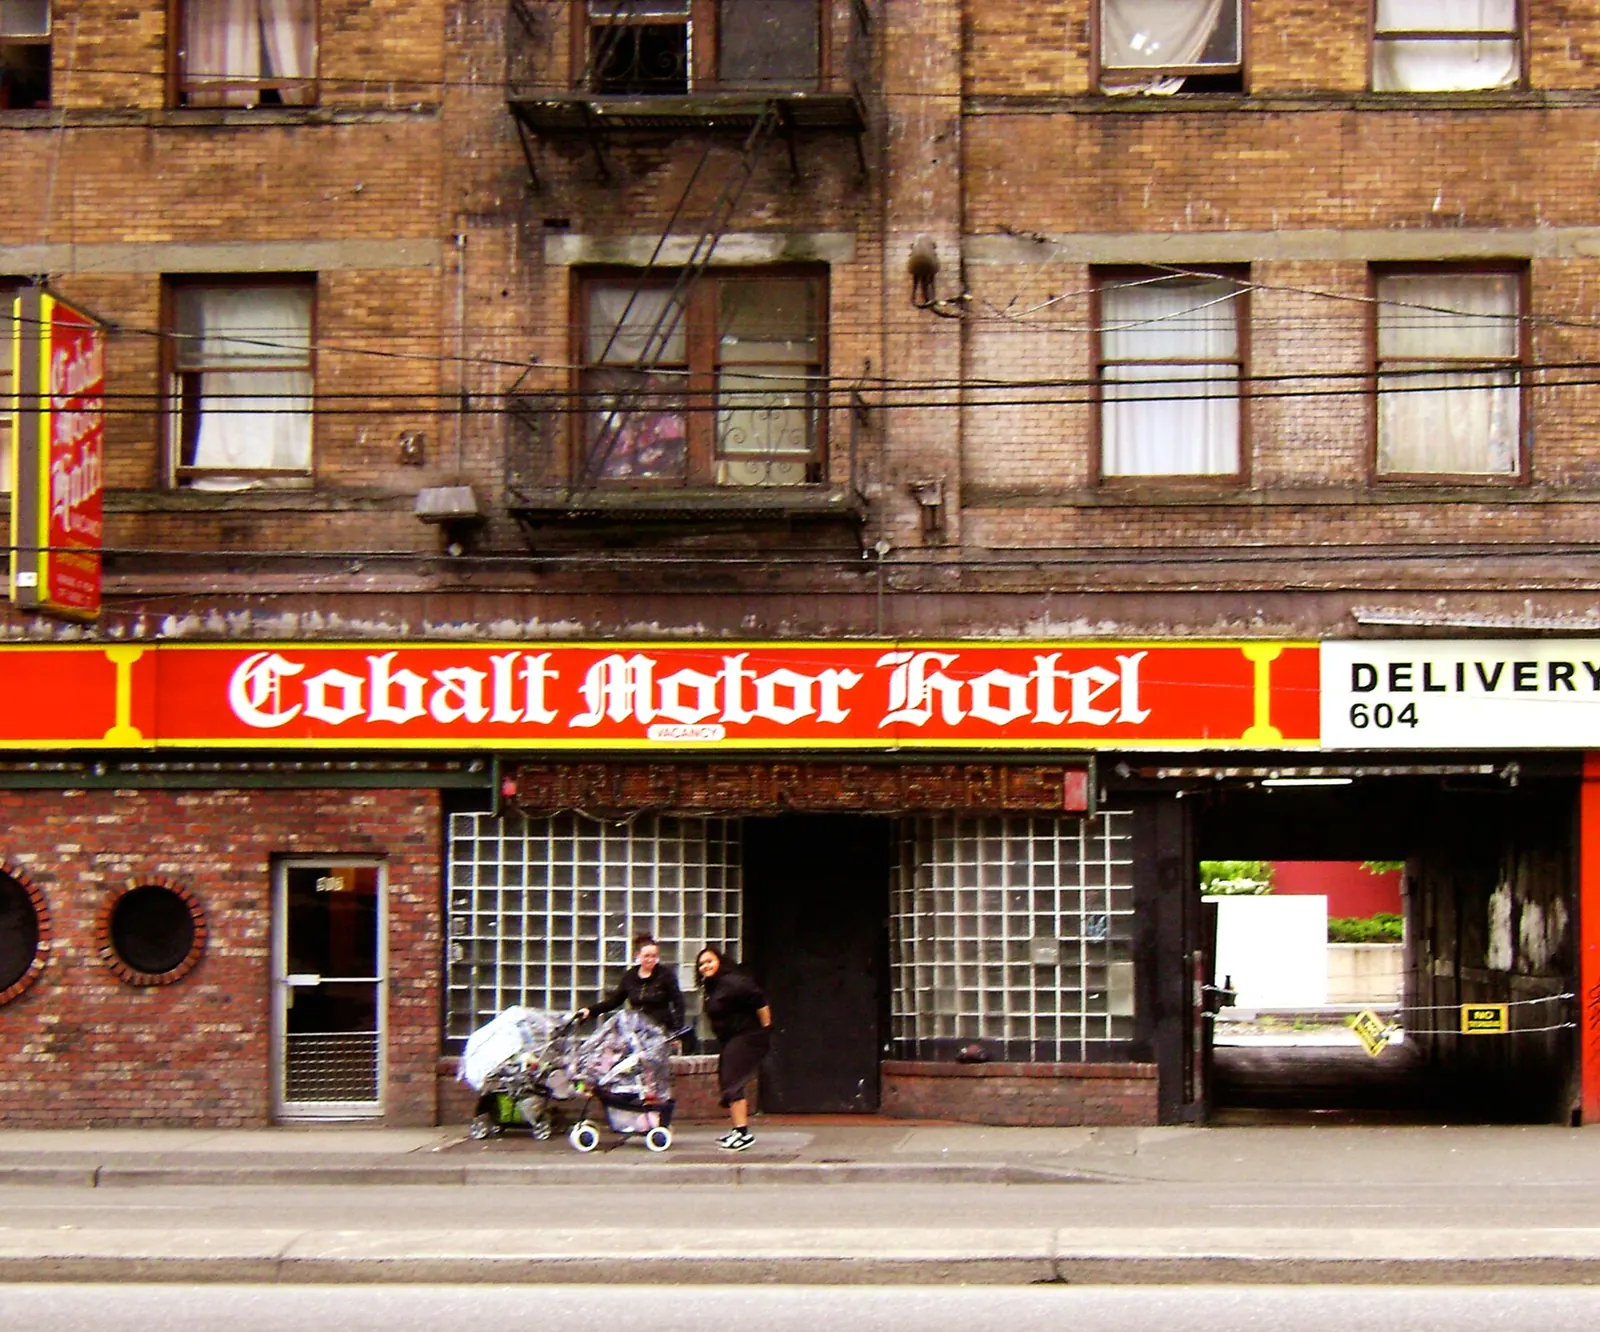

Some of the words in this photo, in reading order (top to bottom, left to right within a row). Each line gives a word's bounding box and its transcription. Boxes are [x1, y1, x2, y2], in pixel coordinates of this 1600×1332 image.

[228, 651, 560, 728] Cobalt
[568, 652, 864, 728] Motor
[876, 650, 1152, 729] Hotel
[1351, 661, 1600, 692] DELIVERY
[1350, 702, 1419, 728] 604
